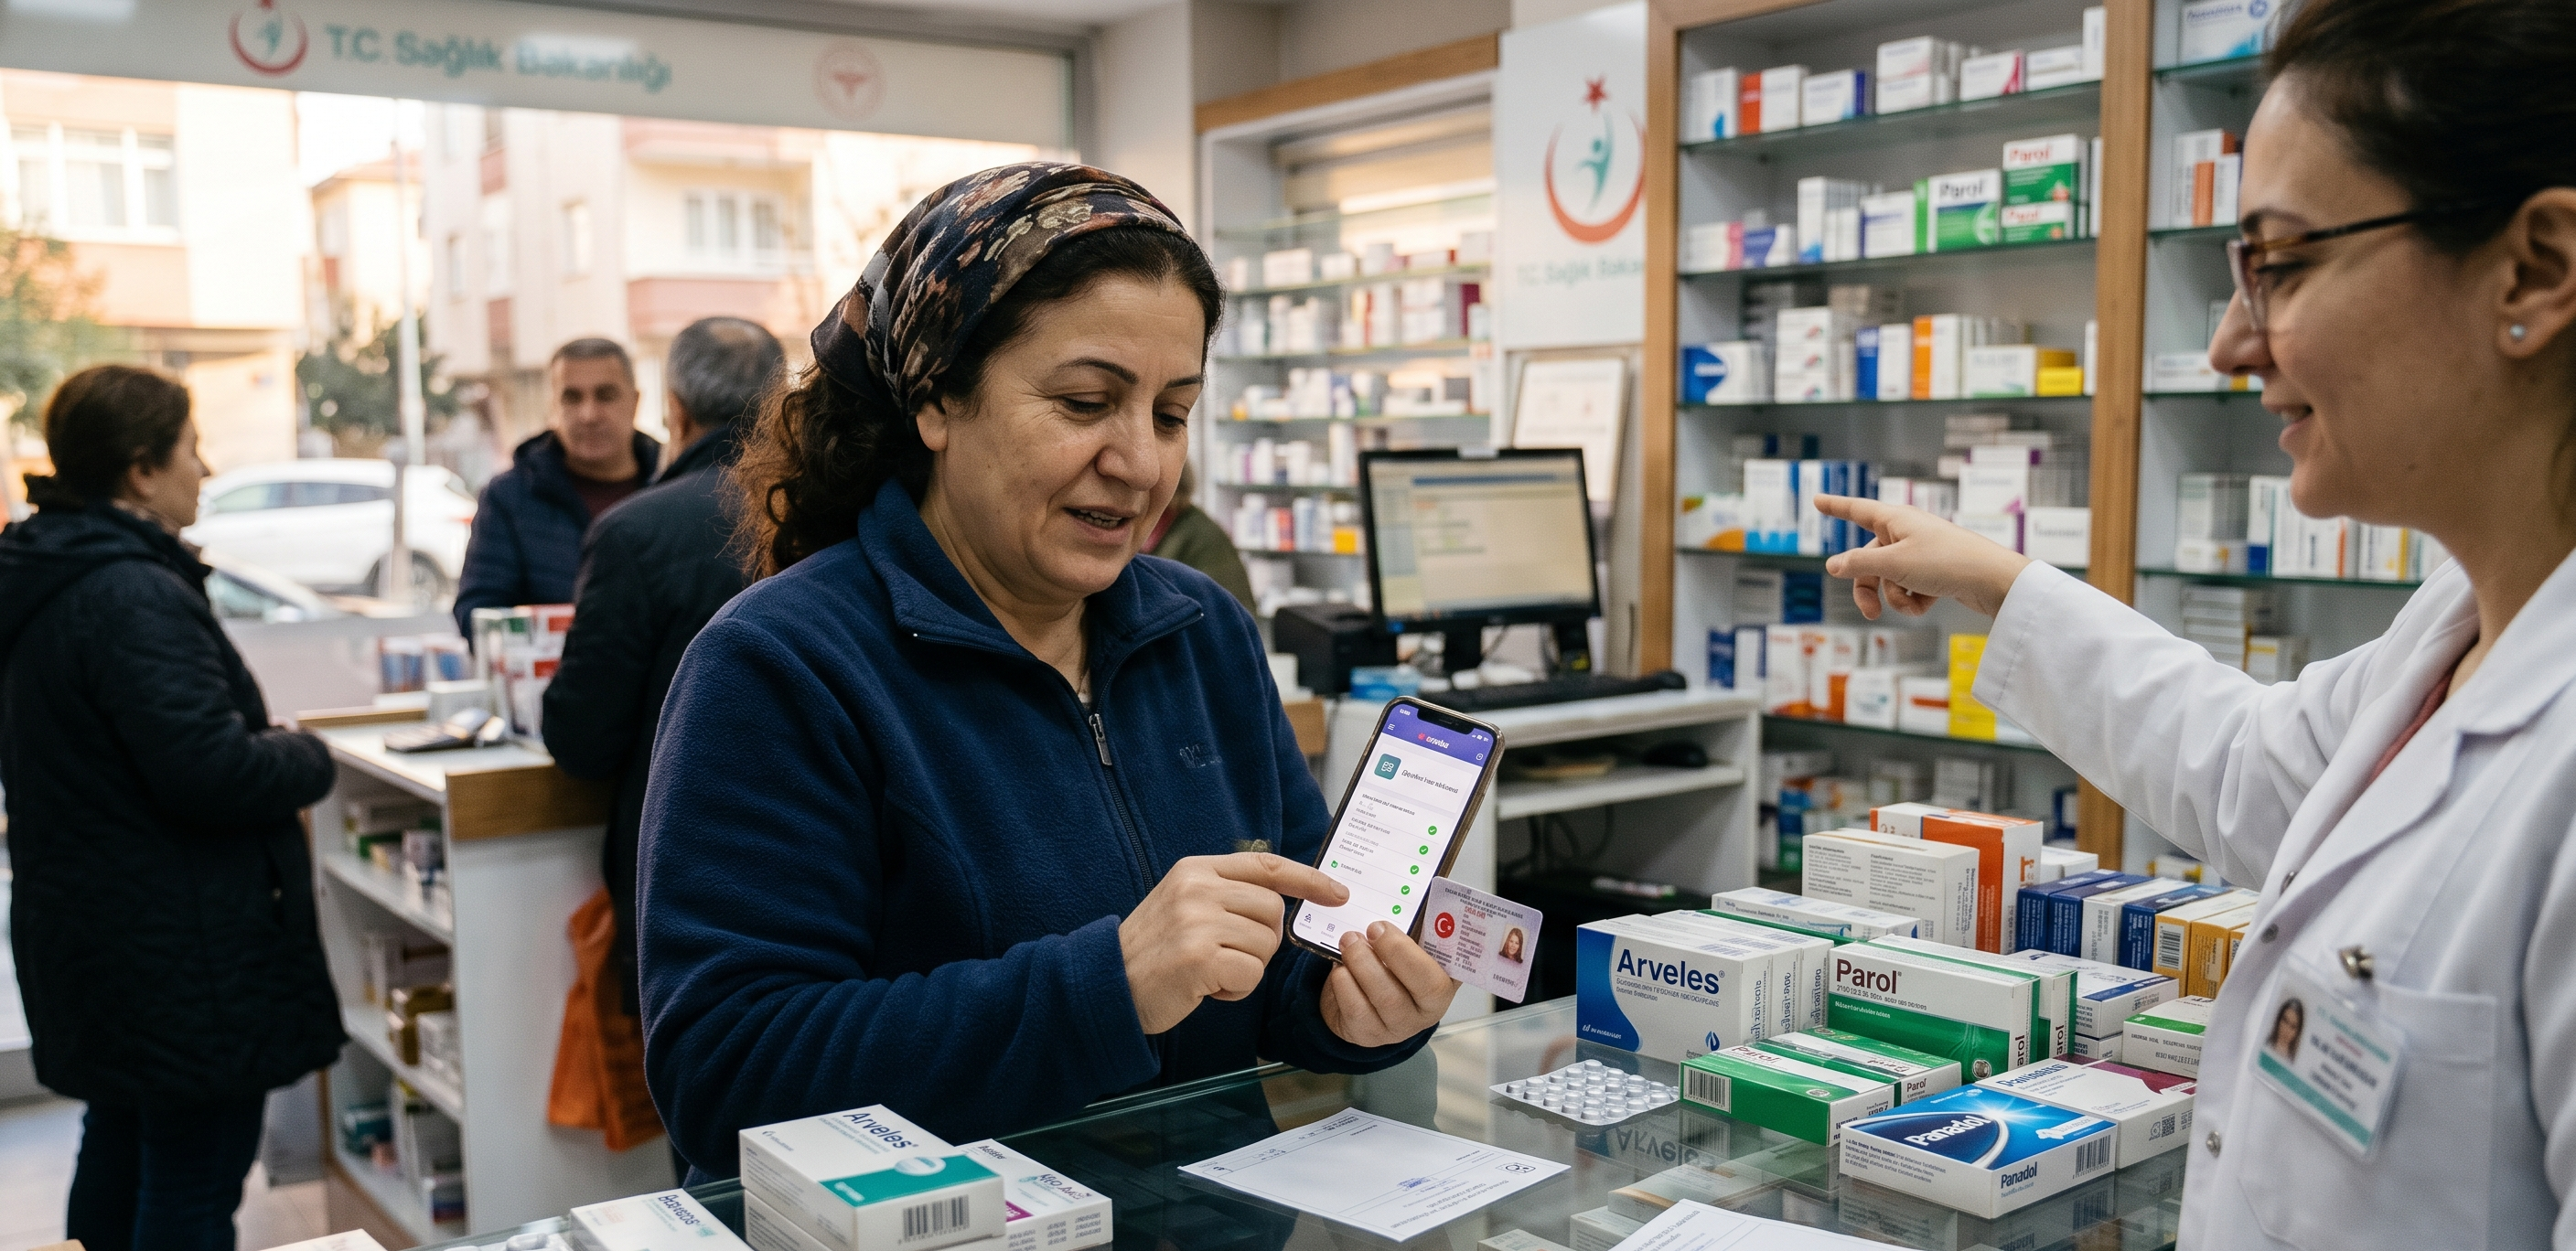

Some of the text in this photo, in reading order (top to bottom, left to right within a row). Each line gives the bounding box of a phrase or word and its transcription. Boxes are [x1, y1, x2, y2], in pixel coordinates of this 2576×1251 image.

[1616, 948, 1725, 995] Arveles®
[2014, 1034, 2025, 1067] arol
[2055, 1024, 2065, 1055] arol
[843, 1113, 912, 1149] Arveles
[1904, 1114, 1994, 1146] Panadol
[2001, 1161, 2038, 1189] Panadol
